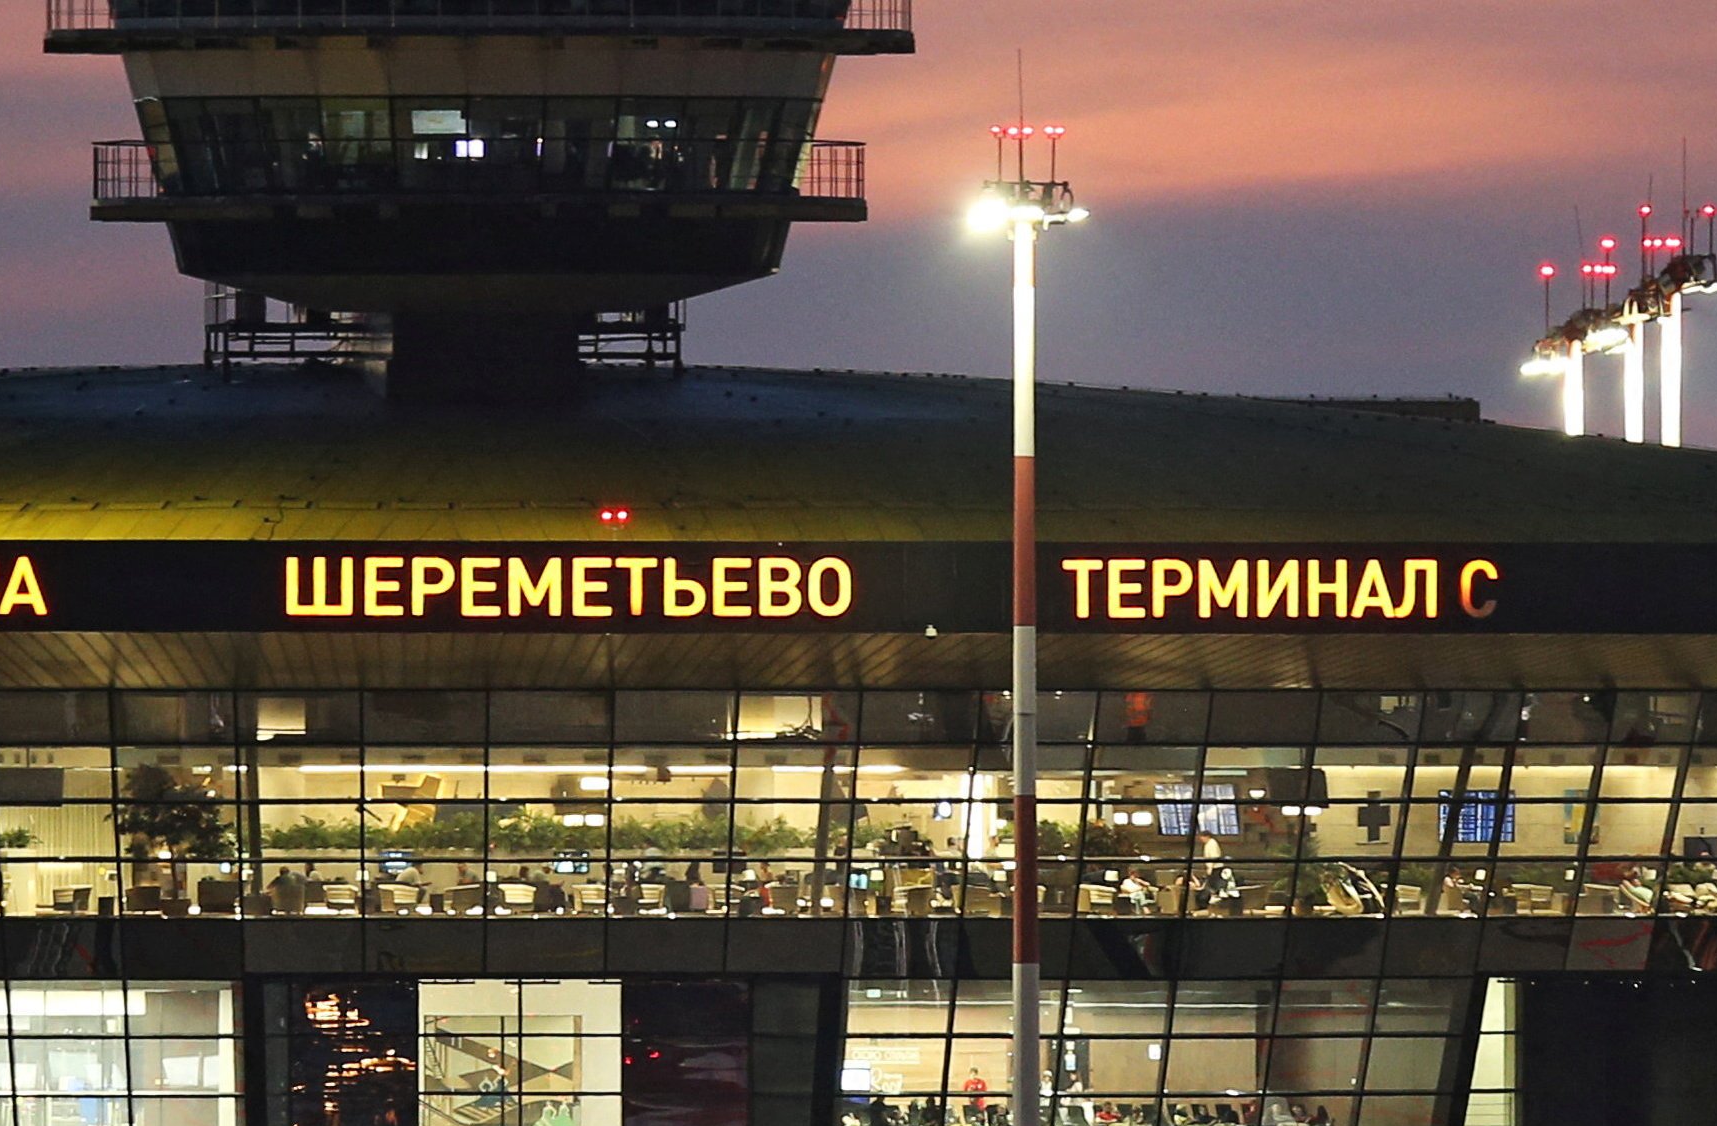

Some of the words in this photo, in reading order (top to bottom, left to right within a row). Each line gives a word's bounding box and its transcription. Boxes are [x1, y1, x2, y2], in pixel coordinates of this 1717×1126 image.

[284, 556, 853, 618] ШЕРЕМЕТЬЕВО
[1062, 558, 1438, 619] ТЕРМИНАЛ
[1460, 559, 1499, 618] С
